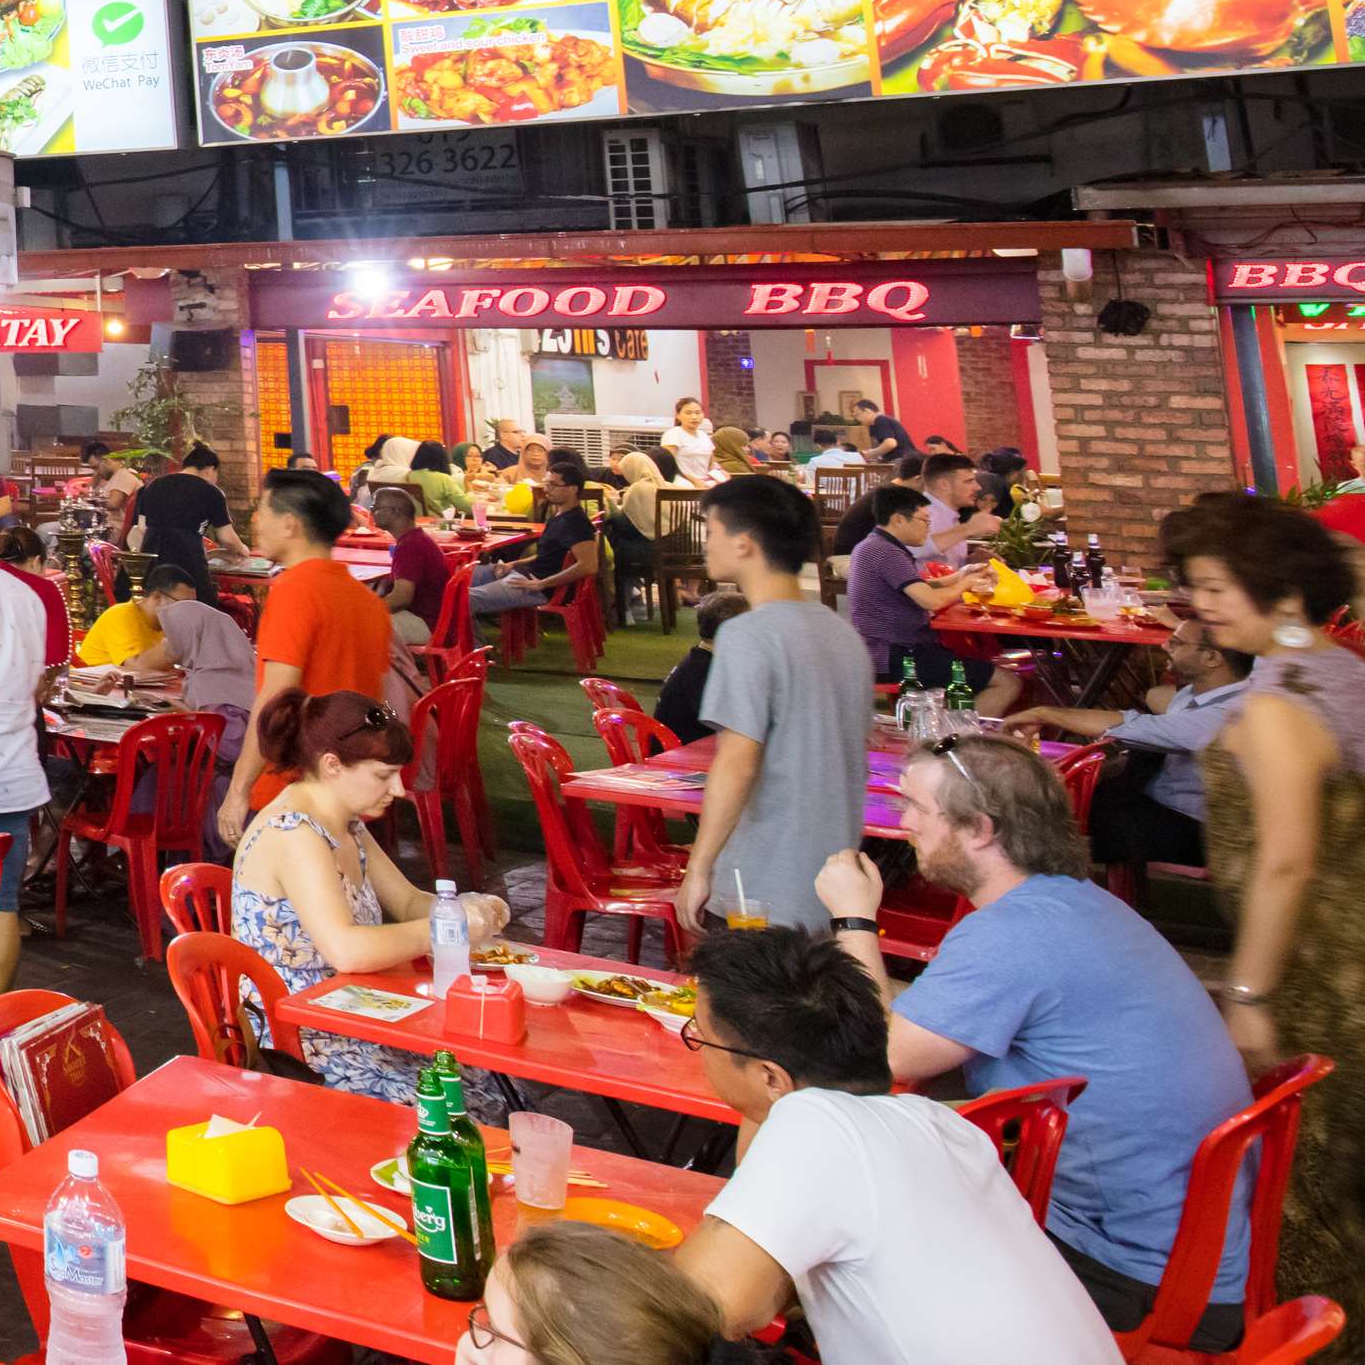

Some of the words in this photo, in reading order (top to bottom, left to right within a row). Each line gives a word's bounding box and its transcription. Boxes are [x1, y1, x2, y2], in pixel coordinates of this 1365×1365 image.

[401, 39, 442, 55] Sweet
[443, 37, 463, 51] and
[465, 36, 497, 51] sour
[497, 31, 547, 47] chicken
[80, 50, 160, 75] 微信支付
[83, 74, 133, 92] WeChat
[136, 74, 161, 91] Pay
[379, 148, 434, 177] 326
[442, 144, 518, 174] 3622
[327, 285, 667, 322] SEAFOOD
[742, 280, 931, 323] BBQ
[413, 1202, 446, 1232] berg
